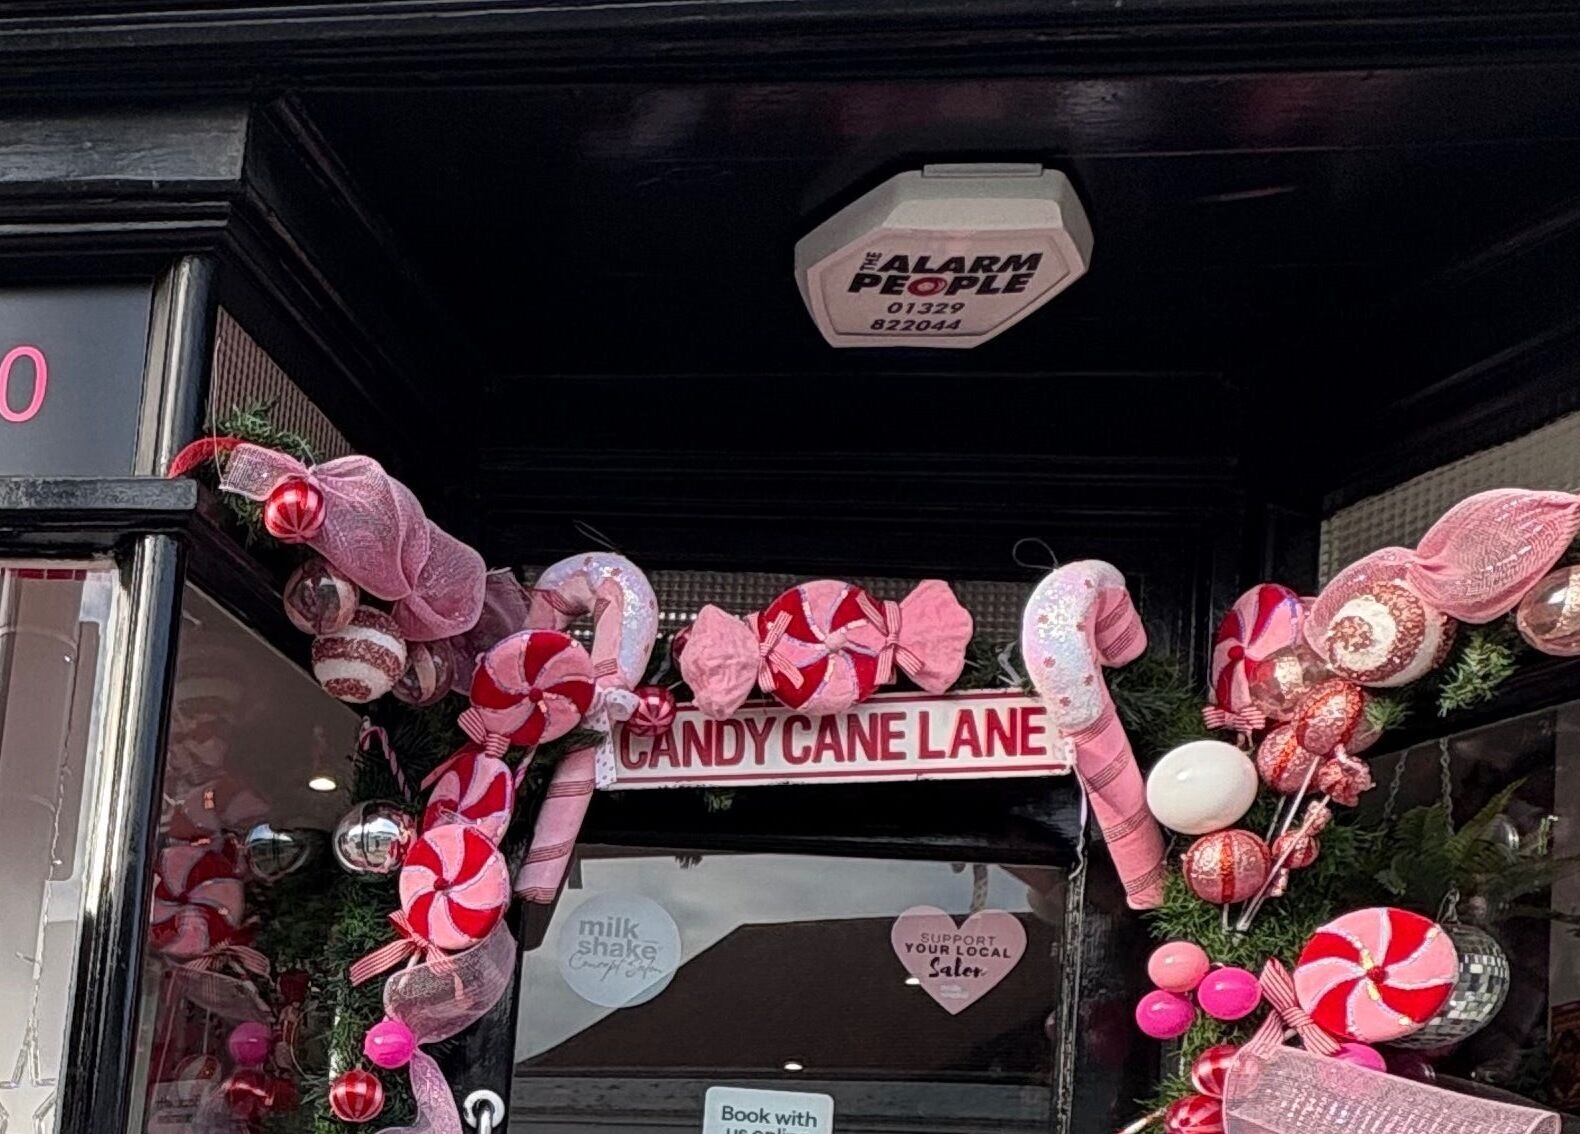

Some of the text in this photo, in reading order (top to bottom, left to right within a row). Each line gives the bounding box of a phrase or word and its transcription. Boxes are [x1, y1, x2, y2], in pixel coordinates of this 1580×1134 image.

[879, 252, 1044, 274] ALARM
[847, 272, 1036, 297] PEOPLE
[886, 301, 966, 316] 01329
[869, 318, 962, 332] 822044
[620, 706, 1048, 771] CANDY CANE LANE
[578, 915, 641, 939] milk
[920, 932, 997, 946] SUPPORT
[905, 942, 1011, 959] YOUR LOCAL
[721, 1105, 818, 1128] Book with
